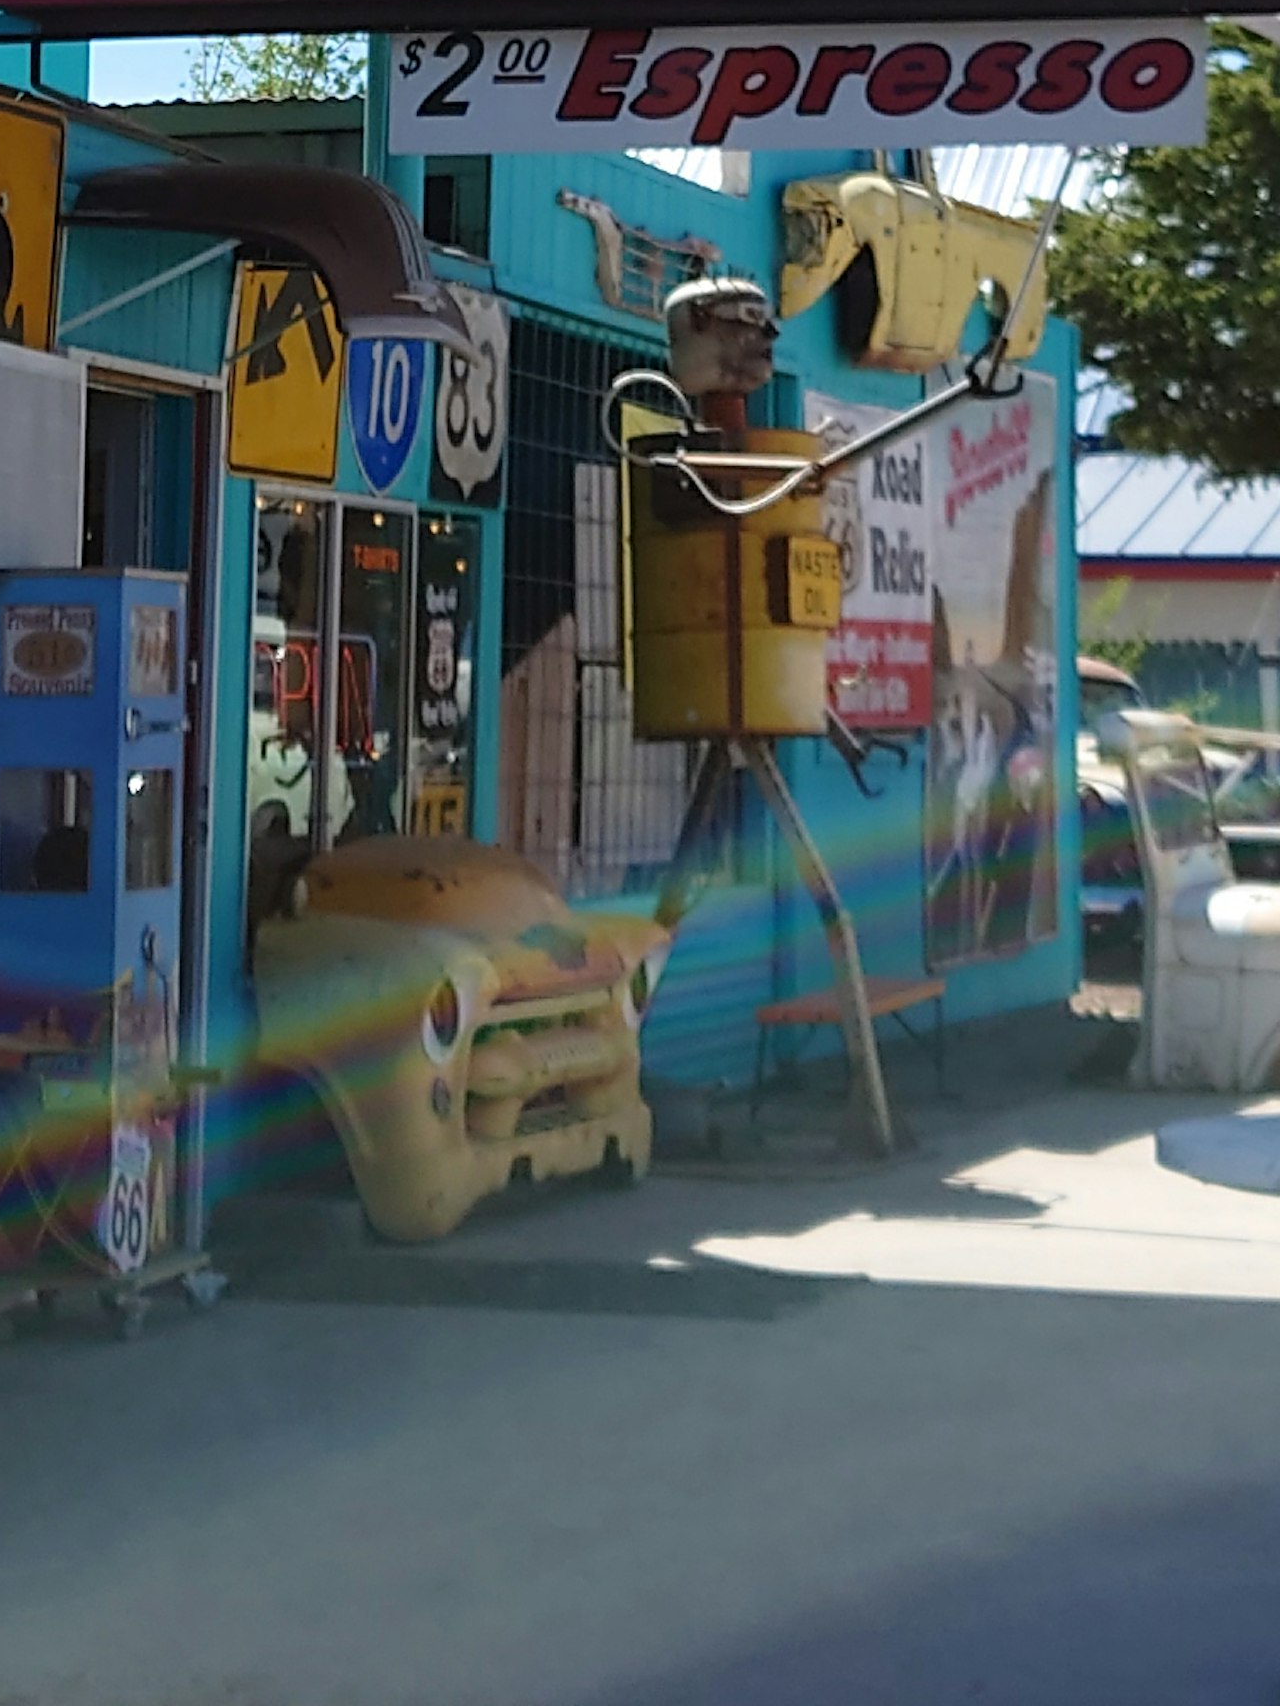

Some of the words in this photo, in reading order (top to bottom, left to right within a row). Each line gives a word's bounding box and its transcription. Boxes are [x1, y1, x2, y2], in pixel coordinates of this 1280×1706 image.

[556, 28, 1195, 146] Espresso
[366, 338, 411, 445] 10
[436, 339, 498, 454] 83
[111, 1171, 142, 1258] 66
